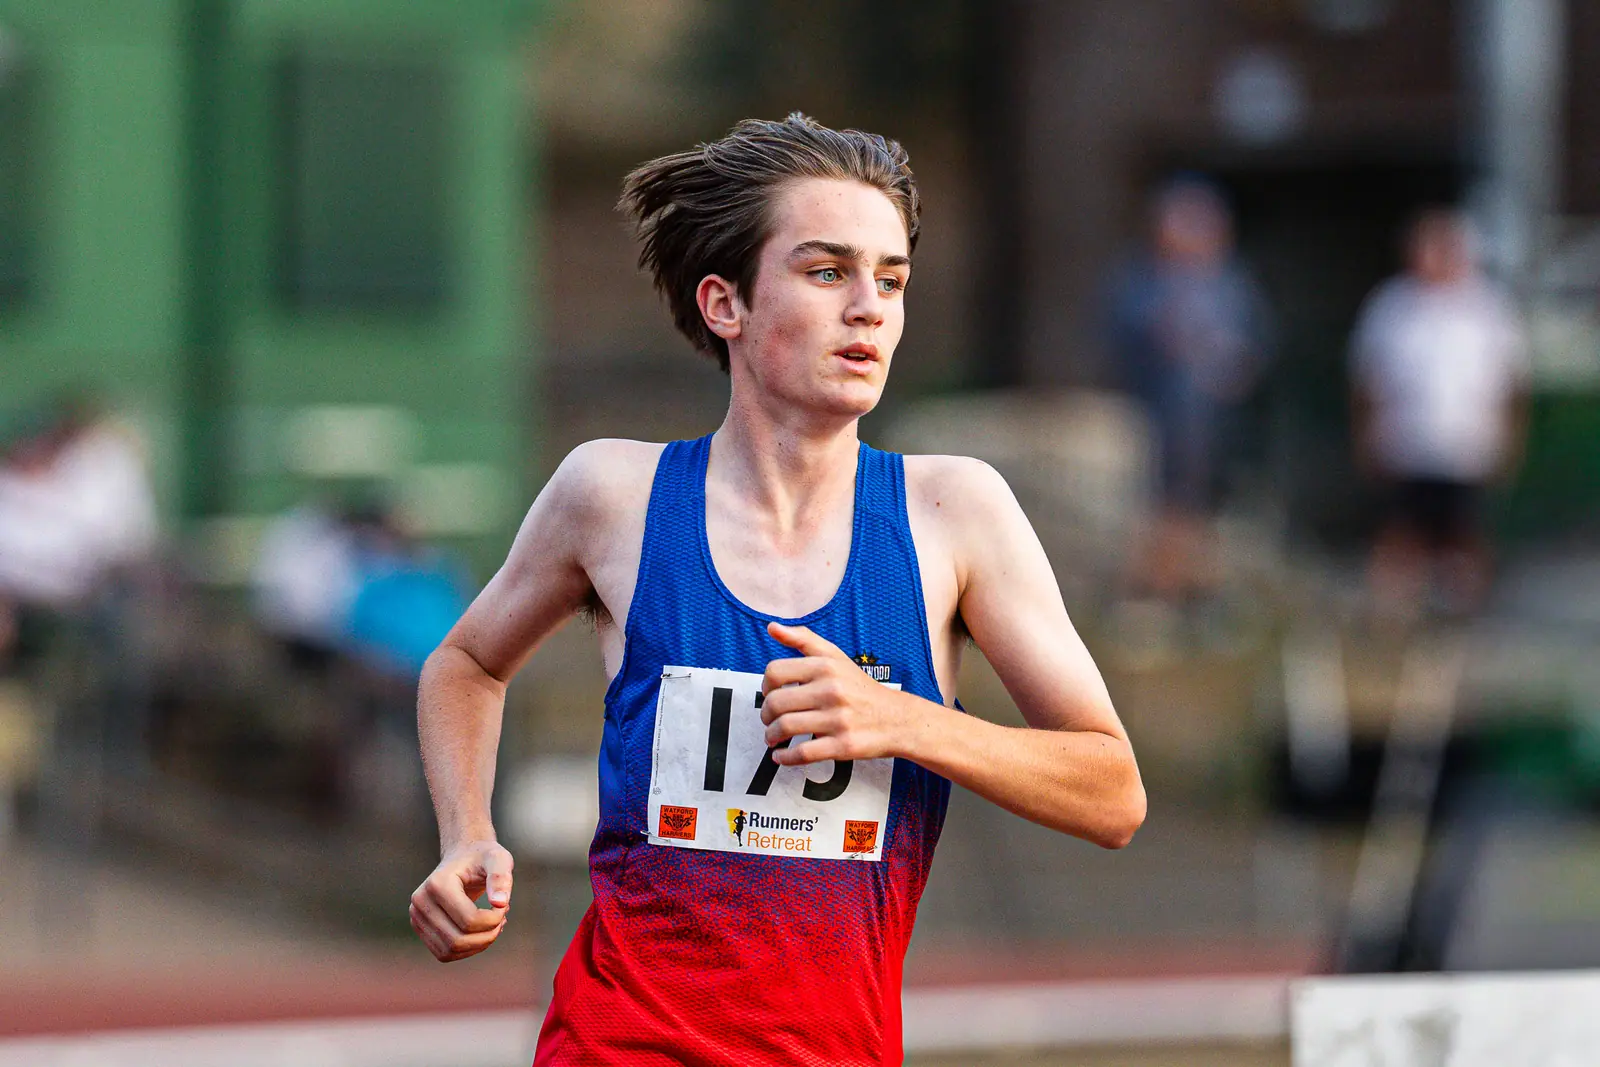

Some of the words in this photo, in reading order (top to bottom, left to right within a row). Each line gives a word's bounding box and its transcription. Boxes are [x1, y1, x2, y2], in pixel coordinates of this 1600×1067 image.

[663, 807, 694, 815] WATFORD
[749, 811, 819, 832] Runners'
[747, 831, 812, 852] Retreat
